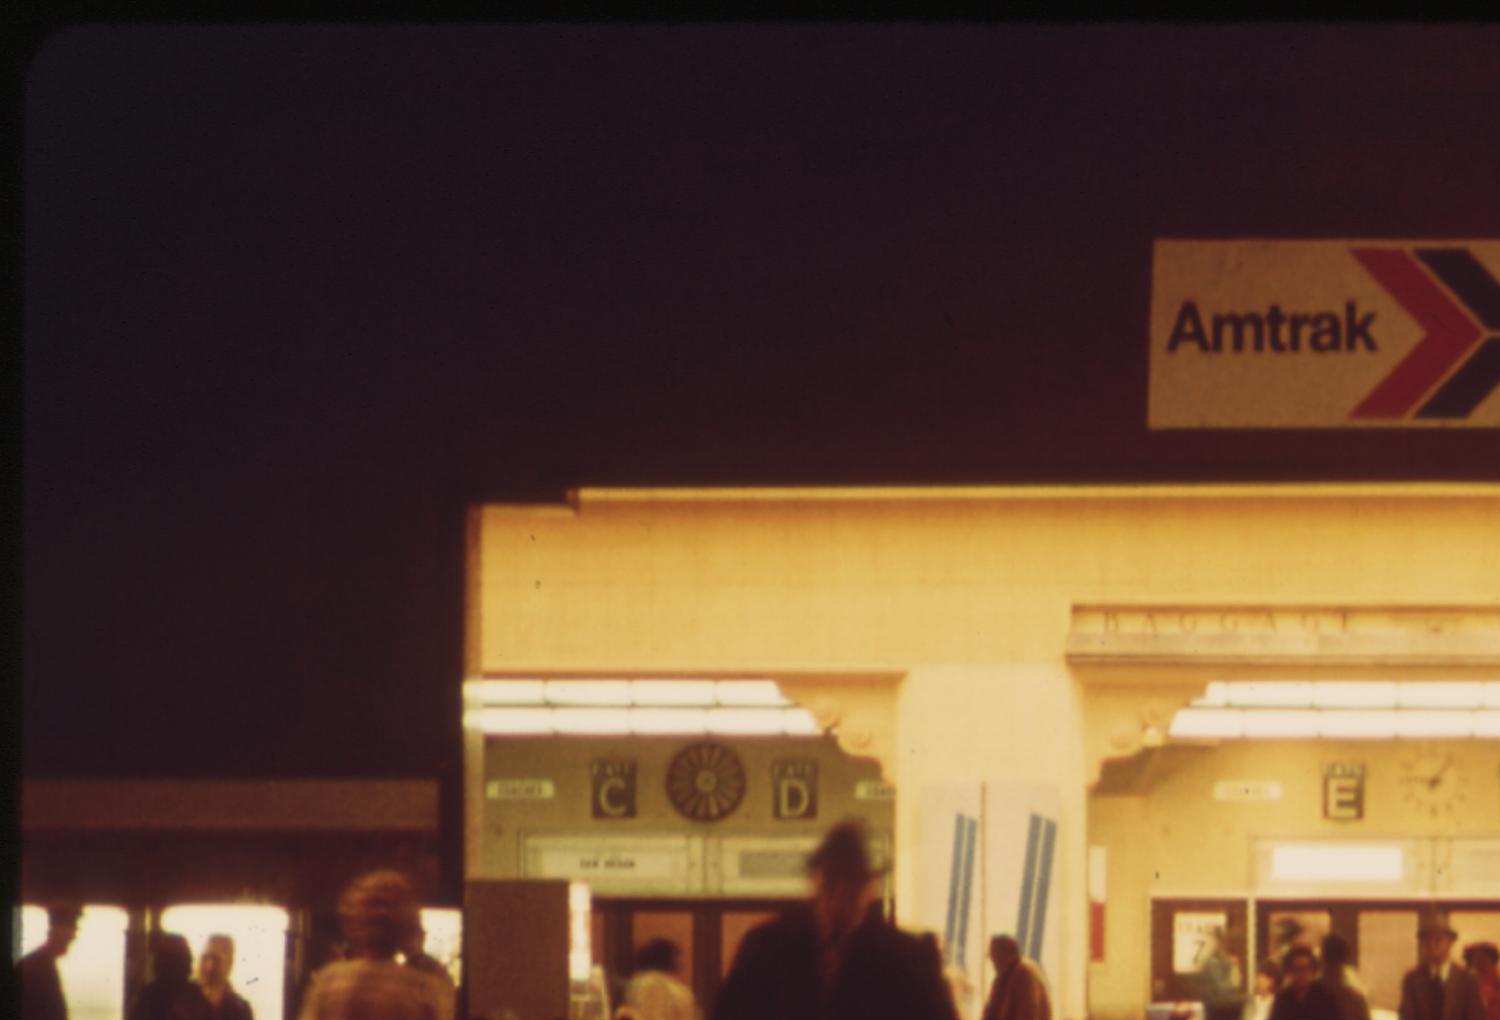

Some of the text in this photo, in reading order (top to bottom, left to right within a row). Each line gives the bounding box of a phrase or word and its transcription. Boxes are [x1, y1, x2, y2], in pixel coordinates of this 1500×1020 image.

[1167, 301, 1379, 353] Amtrak
[601, 778, 626, 816] C
[779, 778, 810, 817] D
[1328, 778, 1358, 817] E
